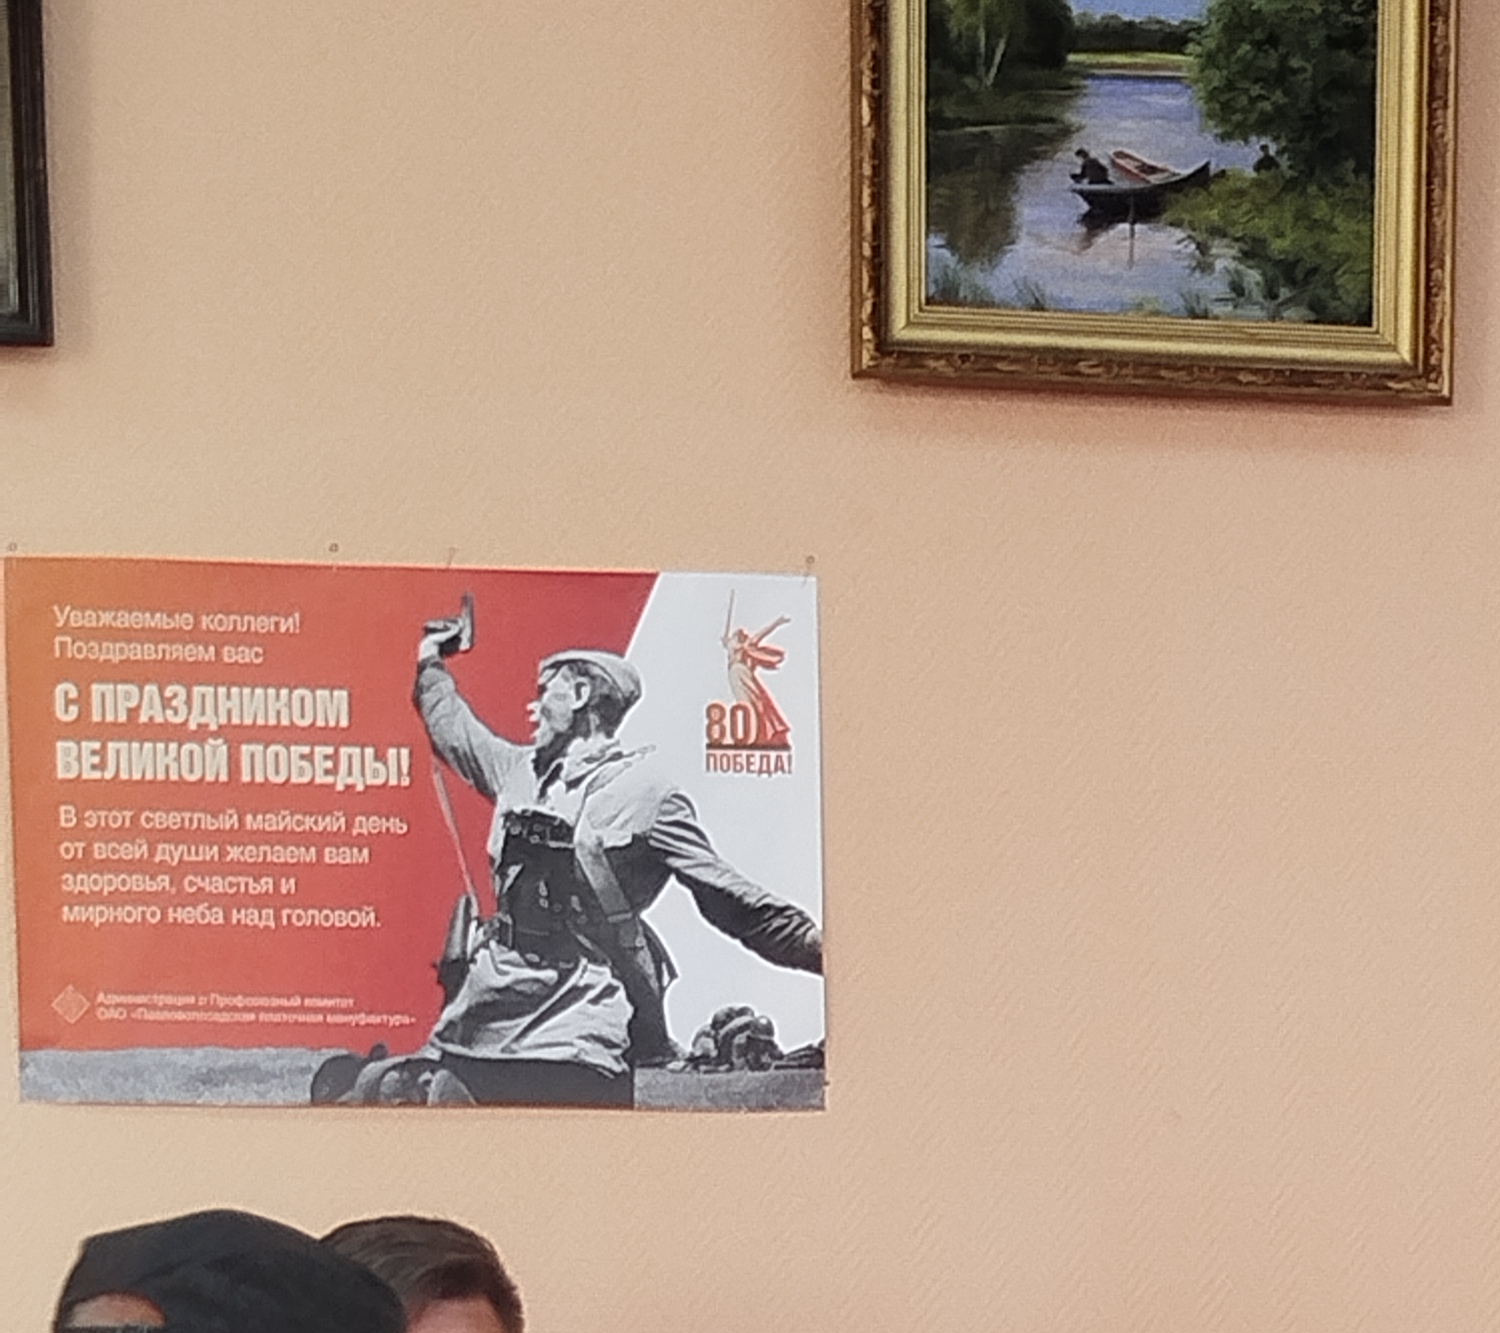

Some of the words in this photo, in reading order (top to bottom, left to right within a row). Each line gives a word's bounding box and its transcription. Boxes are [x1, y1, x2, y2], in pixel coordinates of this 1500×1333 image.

[53, 605, 194, 630] Уважаемые
[201, 612, 300, 635] коллеги!
[54, 637, 215, 663] Поздравляем
[223, 645, 264, 664] вас
[54, 681, 79, 722] С
[92, 682, 349, 731] ПРАЗДНИКОМ
[705, 702, 751, 744] 80
[56, 738, 228, 783] ВЕЛИКОЙ
[241, 743, 411, 792] ПОБЕДЫ!
[705, 753, 793, 777] ПОБЕДА!
[59, 805, 77, 829] В
[84, 808, 134, 829] этот
[140, 807, 240, 830] светлый
[245, 809, 346, 833] майский
[352, 814, 408, 837] день
[60, 841, 86, 860] от
[93, 838, 148, 861] всей
[155, 843, 219, 867] души
[226, 844, 316, 864] желаем
[324, 846, 370, 865] вам
[61, 873, 177, 897] здоровья,
[183, 875, 274, 895] счастья
[280, 876, 297, 895] и
[62, 905, 161, 928] мирного
[167, 903, 225, 926] неба
[232, 908, 275, 930] над
[282, 905, 382, 929] головой.
